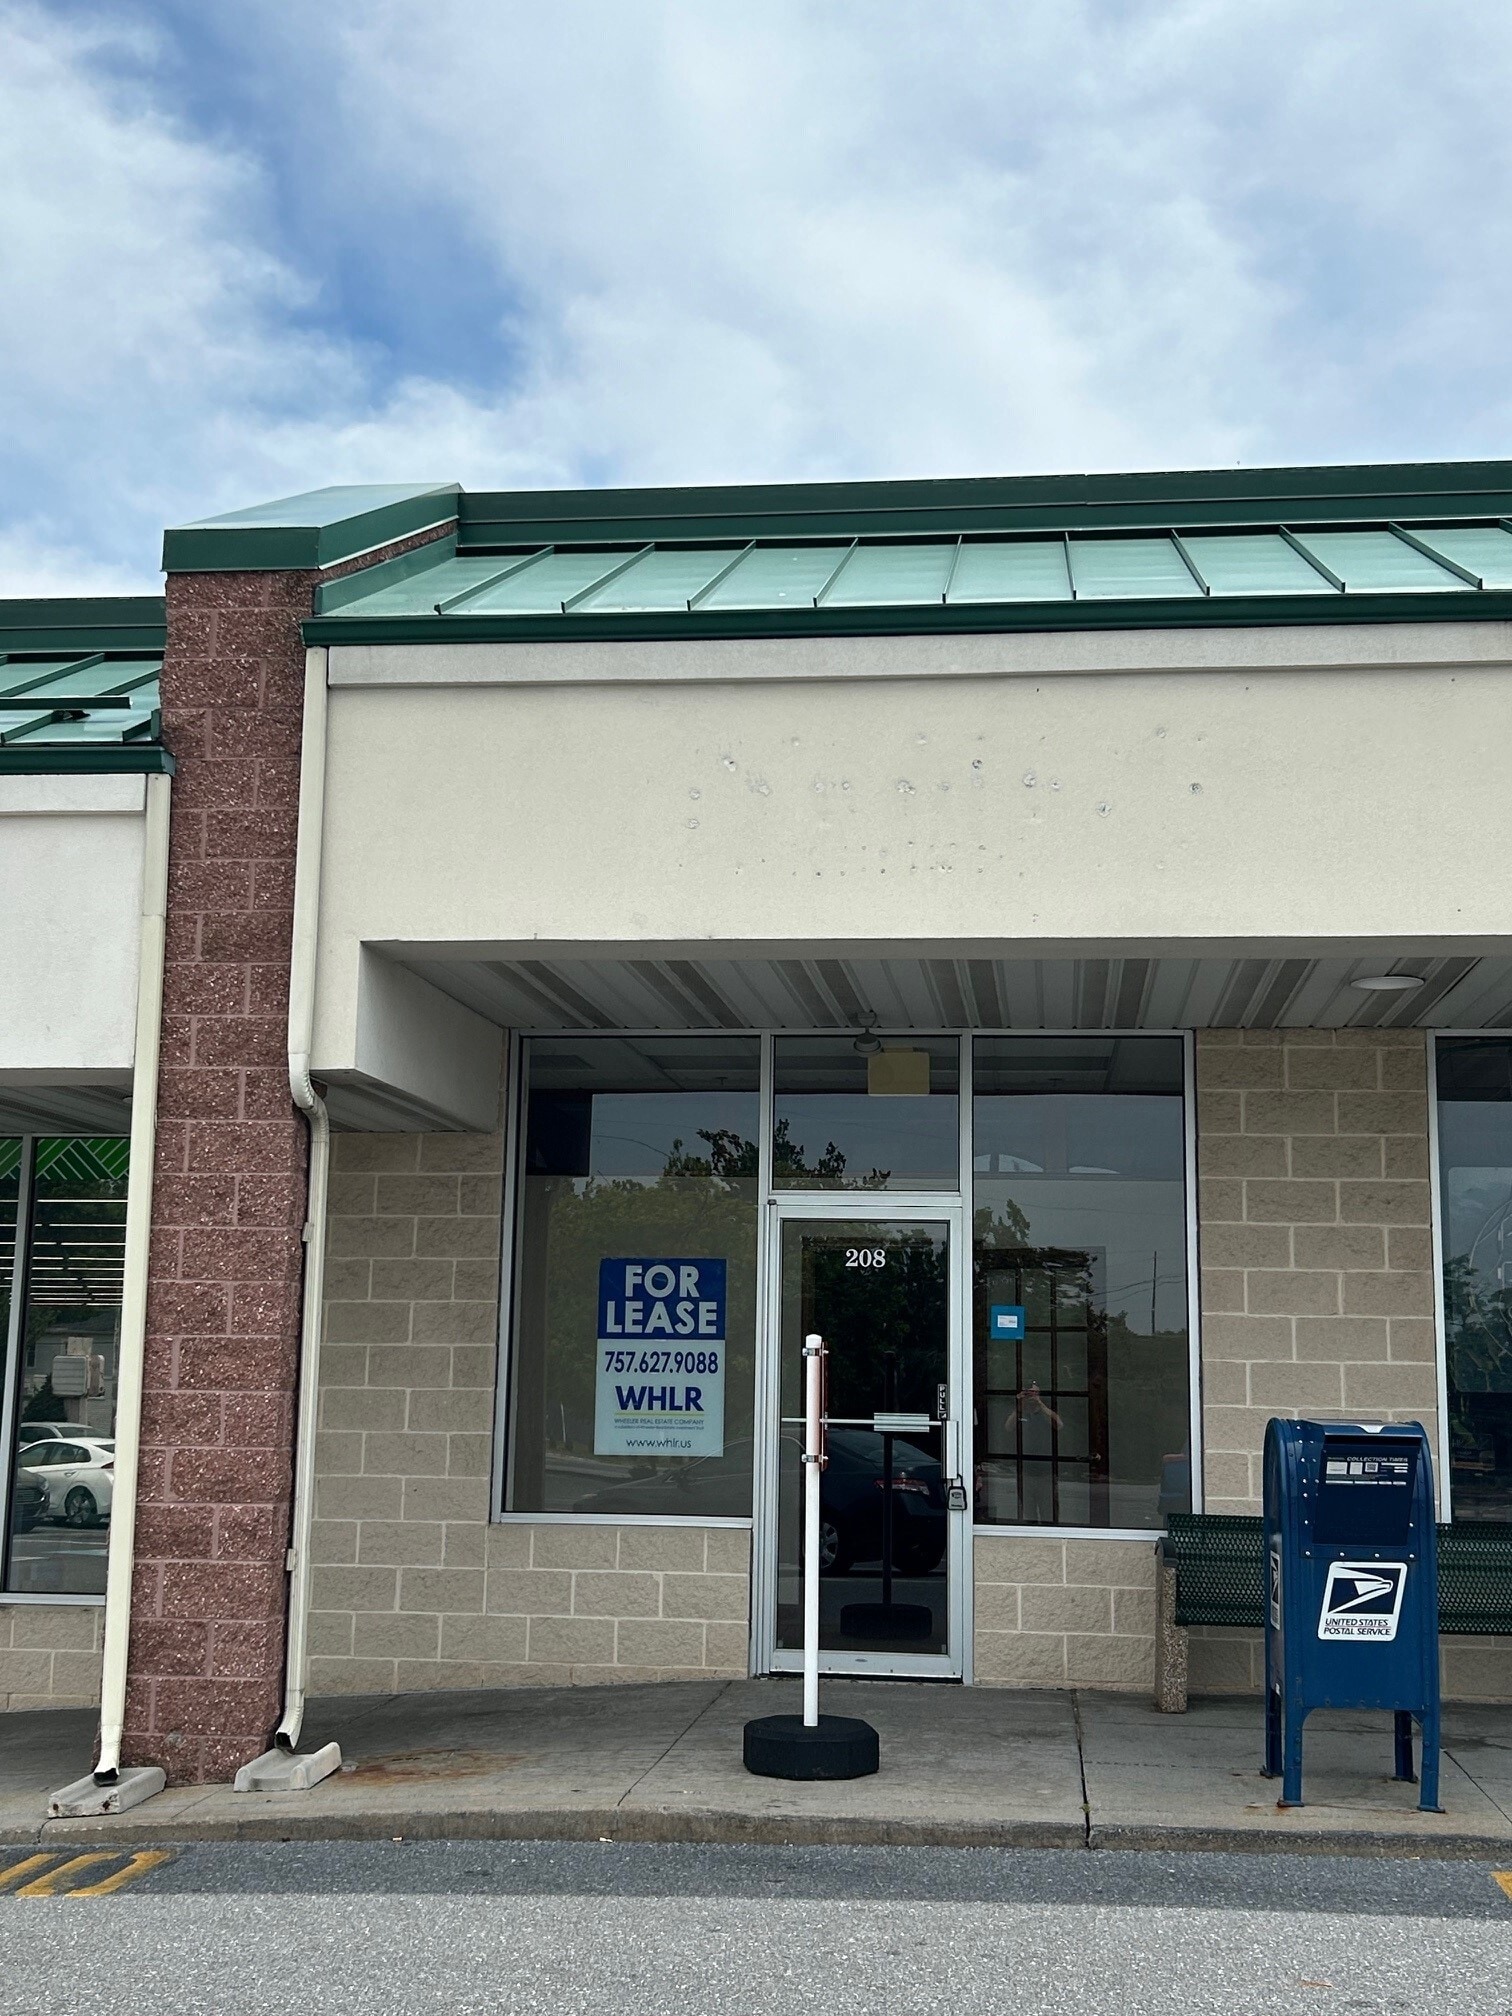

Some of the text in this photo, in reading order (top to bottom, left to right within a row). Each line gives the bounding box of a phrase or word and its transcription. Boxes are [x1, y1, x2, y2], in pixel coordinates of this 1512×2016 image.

[845, 1249, 886, 1267] 208
[625, 1264, 700, 1298] FOR
[606, 1300, 717, 1335] LEASE
[605, 1351, 718, 1374] 757.627.9088
[615, 1385, 704, 1411] WHLR
[626, 1438, 692, 1448] www.whlr.us
[1323, 1627, 1391, 1636] POSTAL SERVICE
[1325, 1618, 1389, 1626] UNITED STATES
